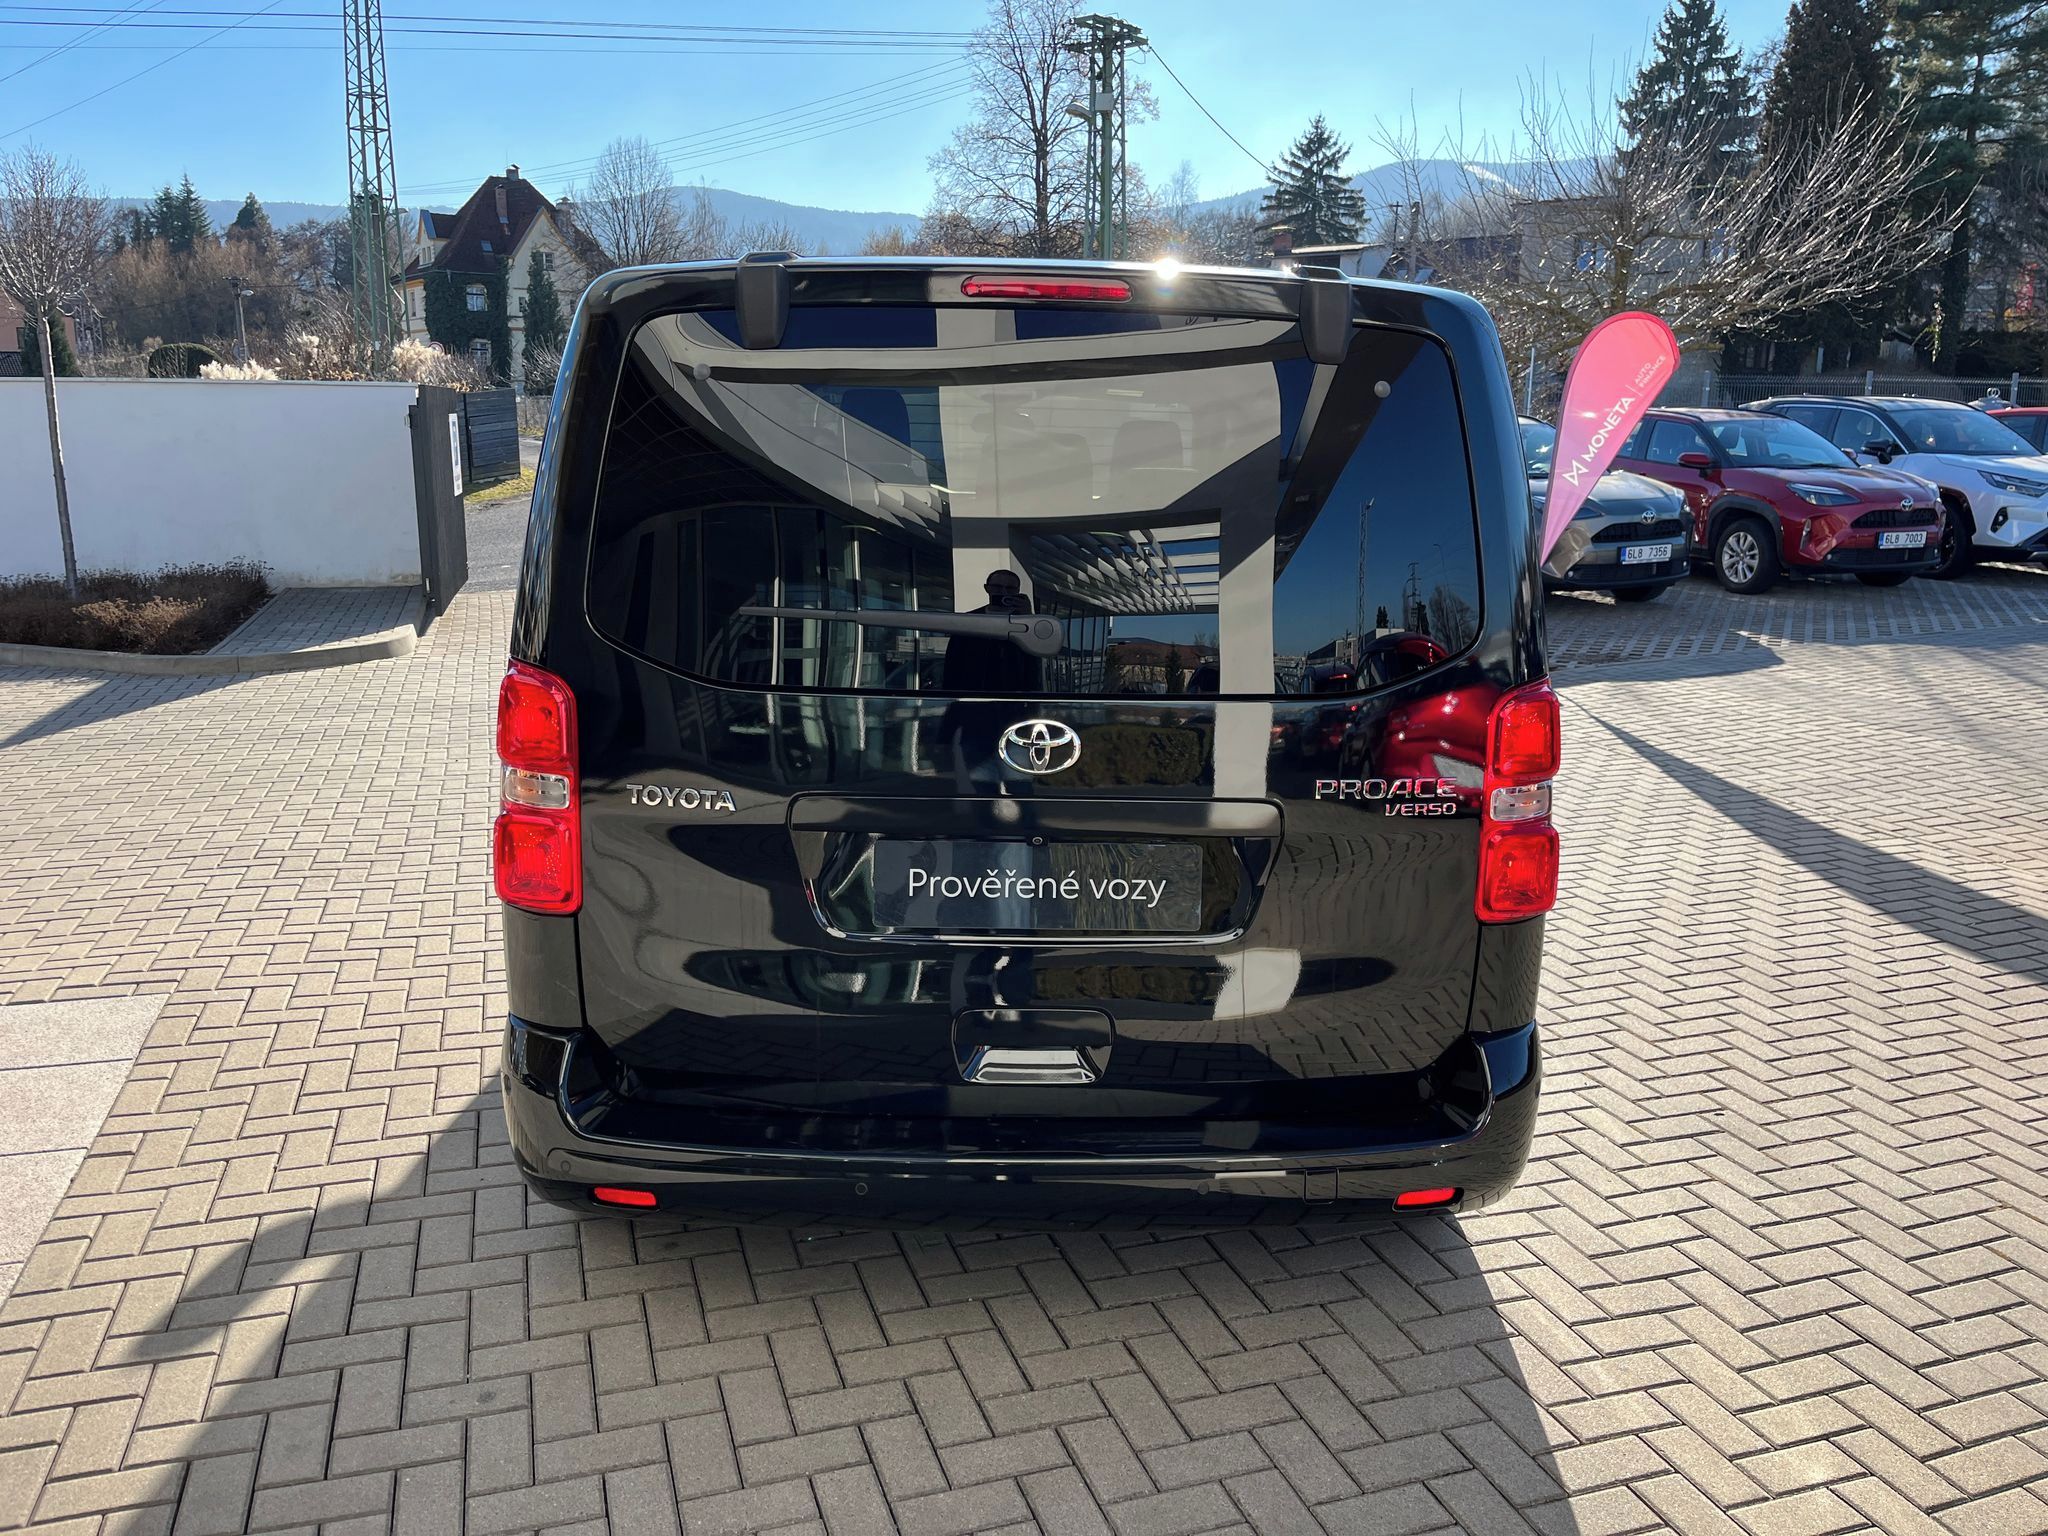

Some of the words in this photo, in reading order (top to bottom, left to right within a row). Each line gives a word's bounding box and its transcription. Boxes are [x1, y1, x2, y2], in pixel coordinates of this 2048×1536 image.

[1634, 362, 1652, 385] AUTO
[1639, 355, 1667, 388] FINANCE
[1580, 397, 1636, 463] MONETA
[1885, 534, 1900, 544] 6L8
[1904, 533, 1923, 544] 7003
[1627, 548, 1643, 559] 6L8
[1648, 546, 1668, 558] 7356
[626, 784, 737, 812] TOYOTA
[1315, 777, 1457, 800] PROACE
[1385, 802, 1457, 816] VERSO
[908, 868, 1080, 899] Prověřené
[1089, 878, 1167, 908] vozy
